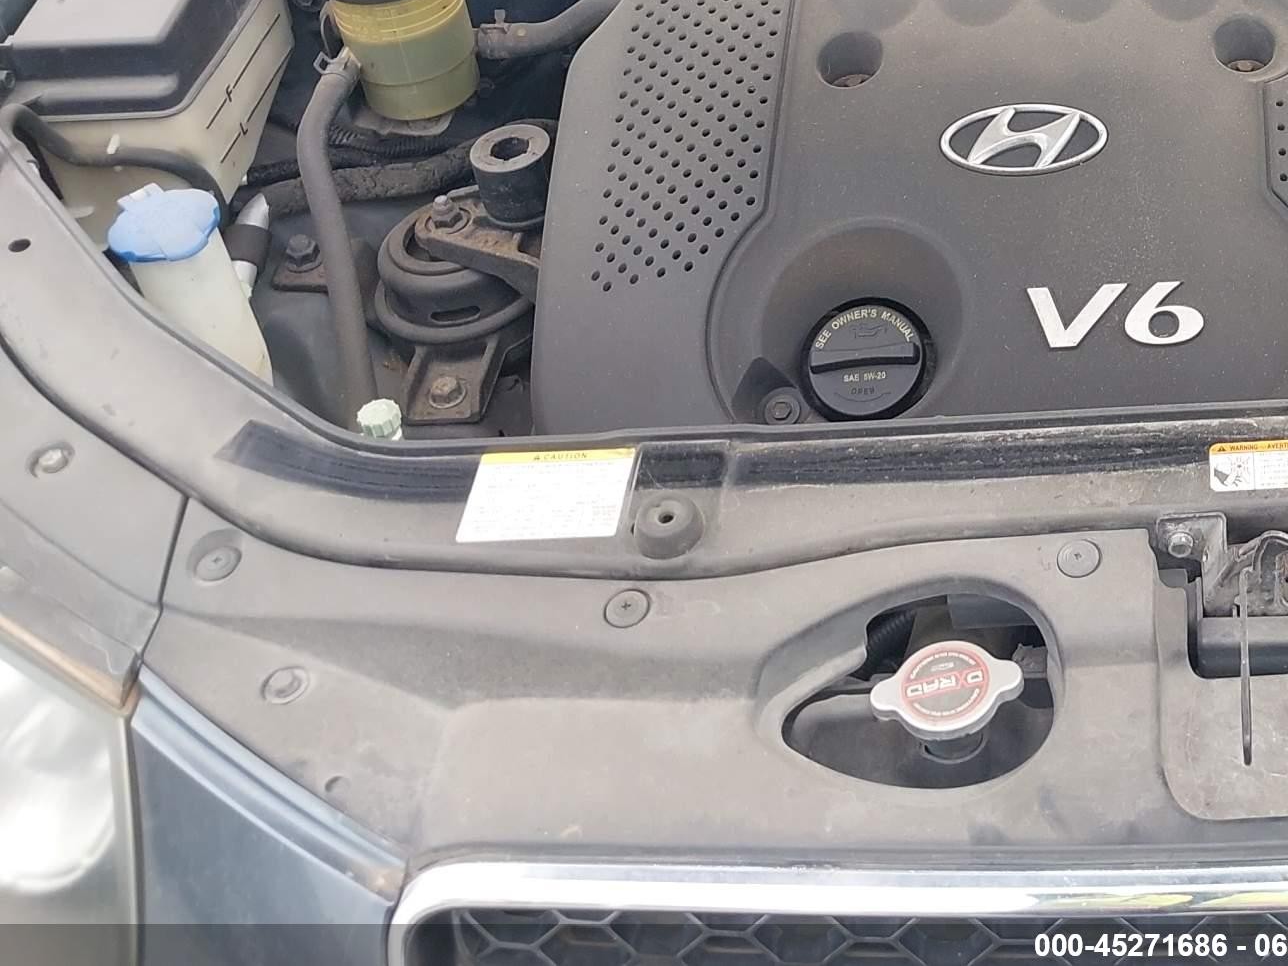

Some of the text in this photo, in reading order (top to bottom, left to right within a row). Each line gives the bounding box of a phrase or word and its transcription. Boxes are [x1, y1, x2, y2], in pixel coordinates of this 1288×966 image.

[1026, 281, 1205, 348] V6
[816, 309, 914, 349] SEE OWNER'S MANUAL
[843, 371, 886, 383] SAE 5W-20
[543, 452, 588, 460] CAUTION
